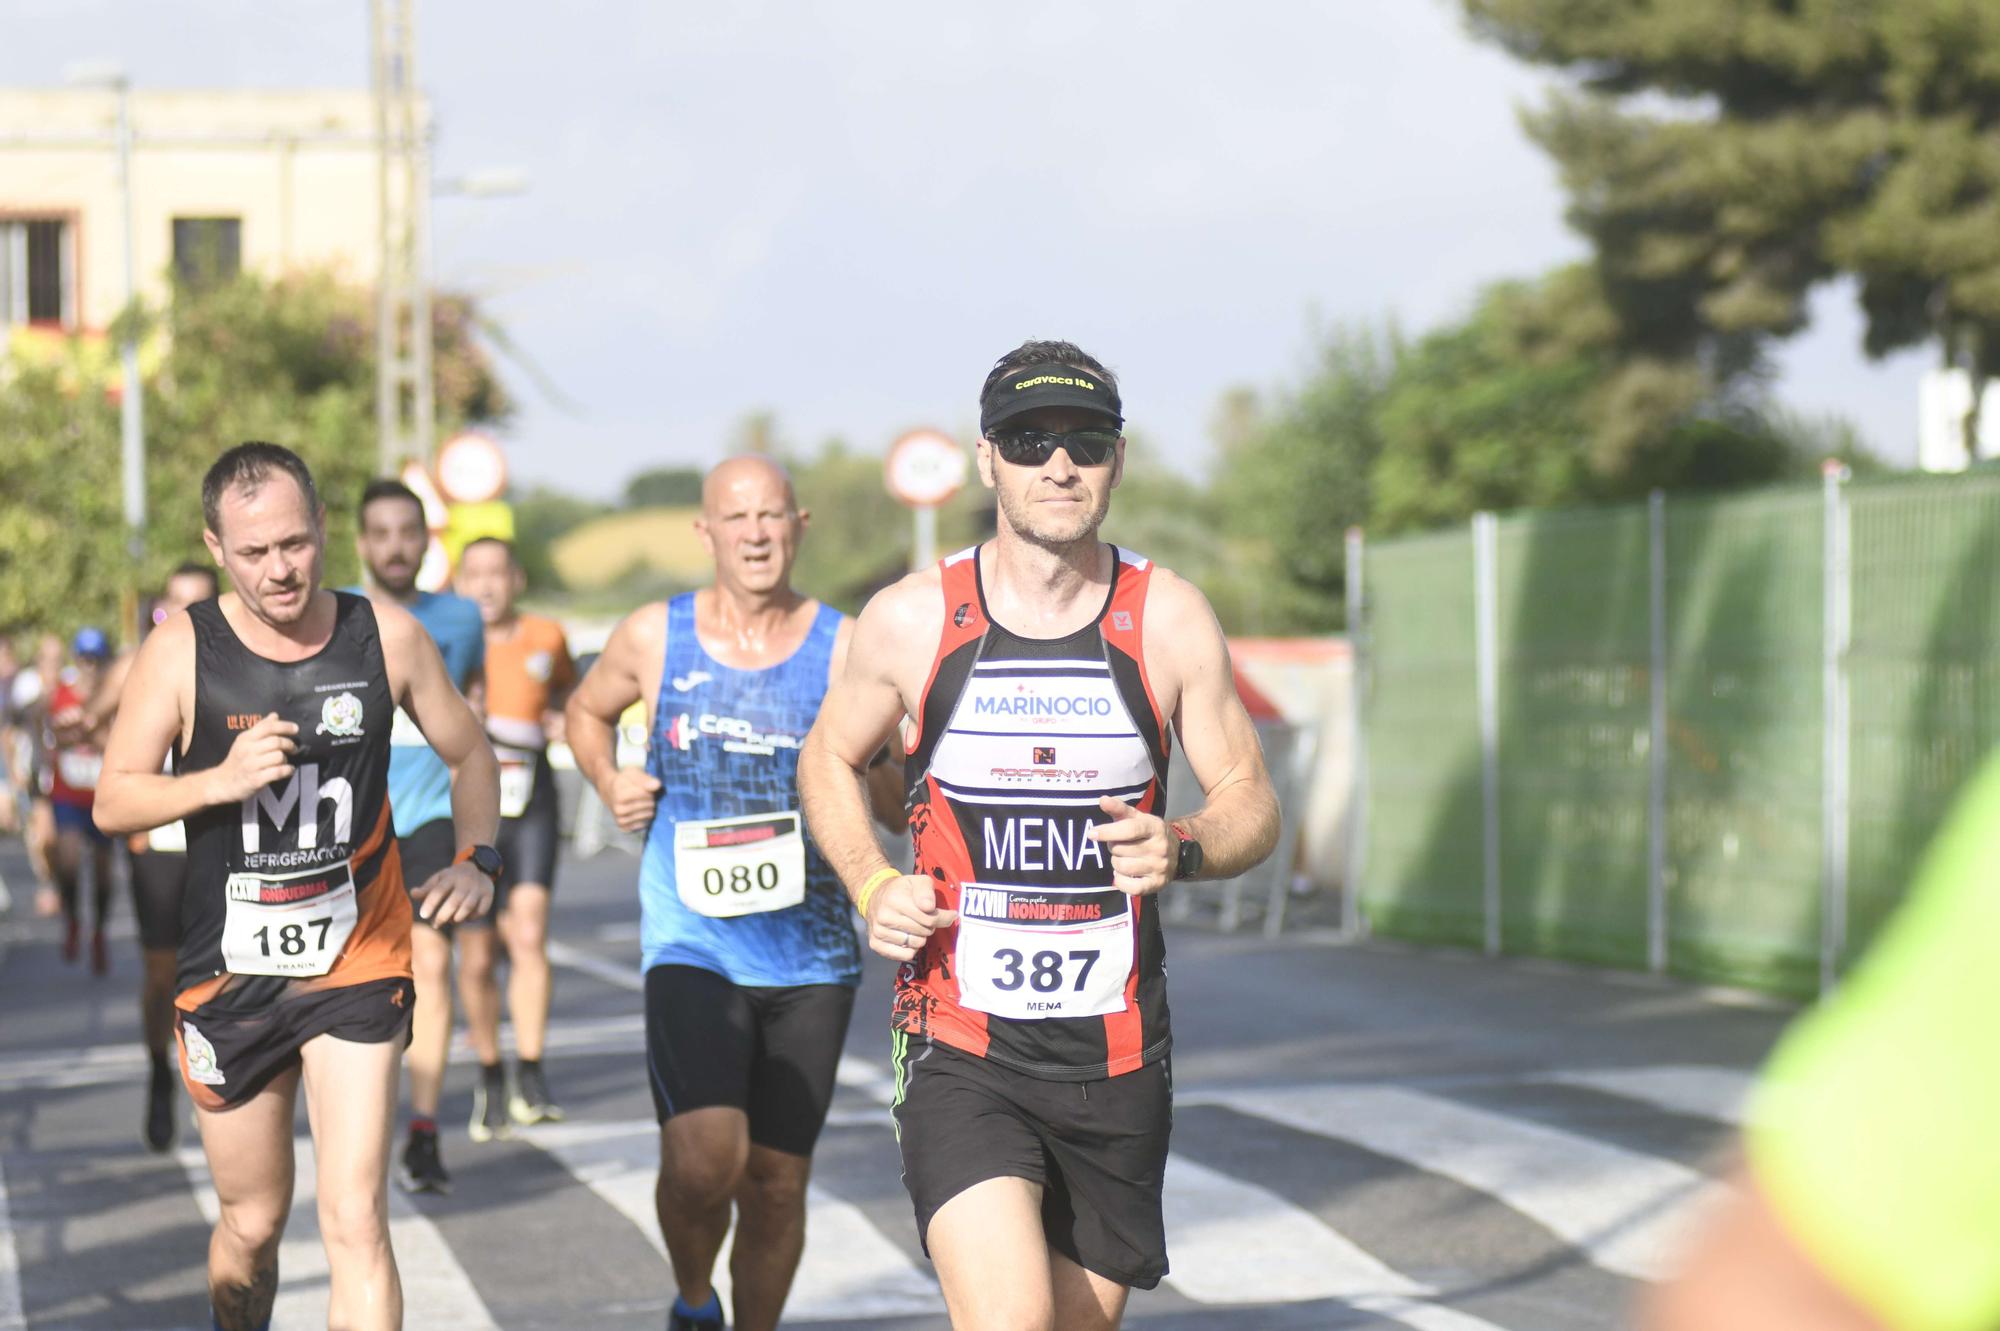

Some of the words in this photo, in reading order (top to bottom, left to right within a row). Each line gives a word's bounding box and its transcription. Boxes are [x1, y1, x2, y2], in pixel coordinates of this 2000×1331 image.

[1015, 376, 1073, 390] caravaca
[974, 697, 1111, 716] MARINOCIO
[984, 817, 1104, 871] MENA
[703, 862, 779, 896] 080
[966, 888, 1007, 919] XXVIII
[1008, 902, 1101, 920] NONDUERMAS
[252, 916, 333, 957] 187
[991, 948, 1101, 993] 387
[1026, 1001, 1062, 1012] MENA
